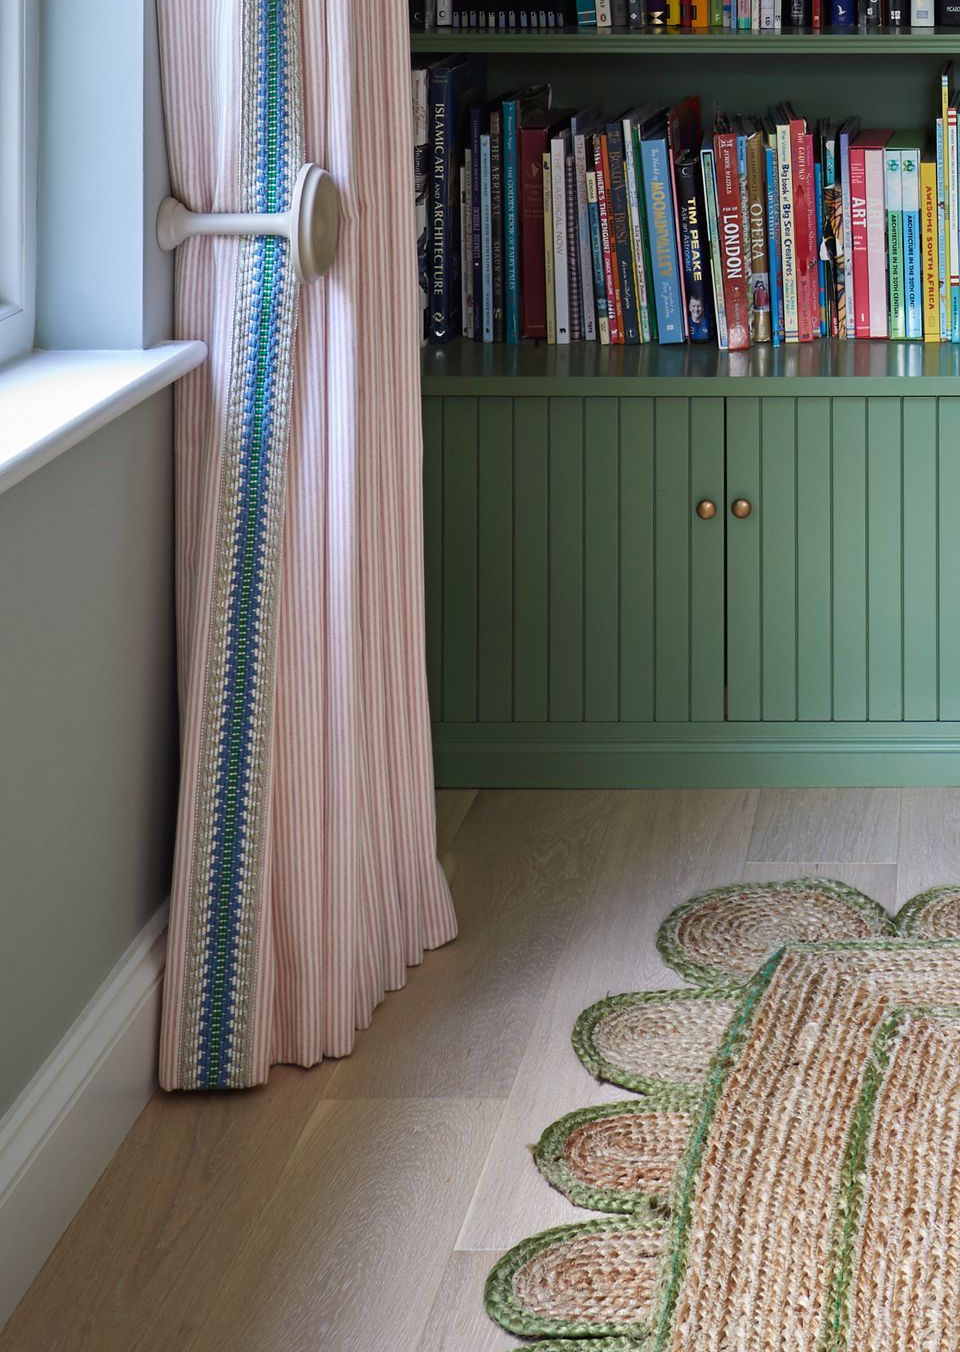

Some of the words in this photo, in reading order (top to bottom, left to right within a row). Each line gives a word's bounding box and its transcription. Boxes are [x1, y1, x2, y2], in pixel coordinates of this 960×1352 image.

[434, 103, 446, 155] ISLAMIC
[491, 138, 501, 160] THE
[434, 156, 446, 181] ART
[491, 164, 501, 218] ARRIVAL
[597, 169, 607, 202] WHERE'S
[602, 218, 612, 254] PENGUIN?
[686, 197, 699, 226] TIM
[851, 196, 868, 228] ART
[926, 186, 935, 232] AWESOME
[651, 181, 673, 276] MOOMINVALLEY
[681, 206, 690, 221] Ask
[749, 204, 765, 261] OPERA
[890, 214, 899, 256] ARCHITECTURE
[433, 201, 445, 297] ARCHITECTURE
[682, 234, 693, 273] Astronaut
[689, 231, 704, 282] PEAKE
[723, 215, 744, 280] LONDON
[926, 237, 934, 271] SOUTH
[927, 274, 936, 311] AFRICA
